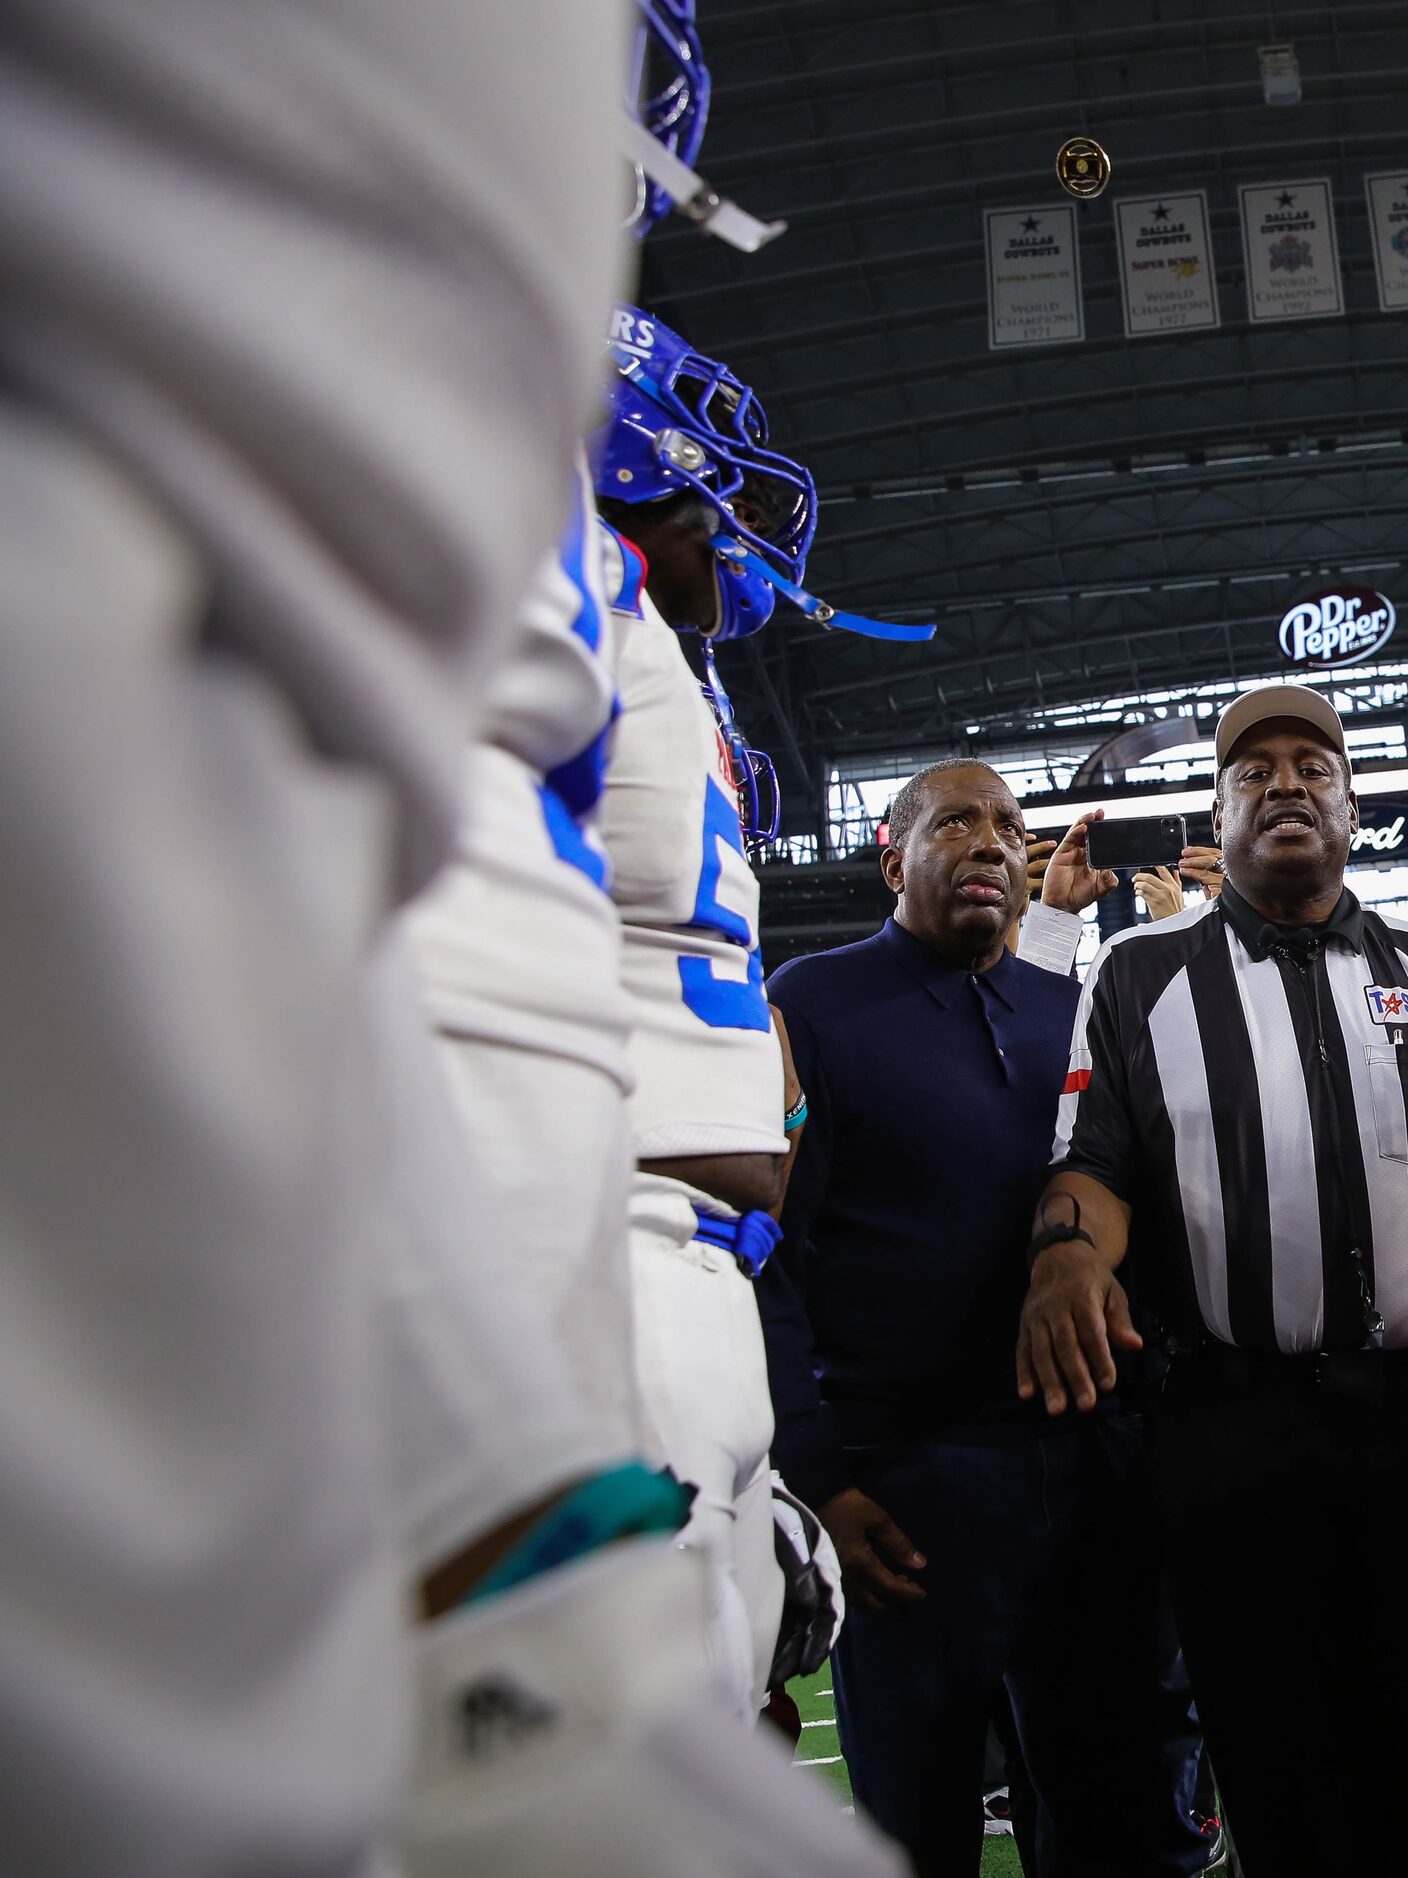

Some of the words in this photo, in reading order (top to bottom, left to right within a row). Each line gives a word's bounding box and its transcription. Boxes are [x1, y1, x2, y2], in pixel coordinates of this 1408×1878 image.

[1265, 210, 1309, 224] DALLAS
[1140, 222, 1185, 237] DALLAS
[1260, 221, 1316, 234] COWBOYS
[1009, 235, 1055, 248] DALLAS
[1136, 233, 1192, 248] COWBOYS
[1004, 245, 1060, 259] COWBOYS
[1131, 259, 1165, 272] SUPER
[1145, 289, 1195, 303] WORLD
[1011, 302, 1061, 314] WORLD
[1131, 299, 1210, 317] CHAMPIONS
[996, 314, 1075, 328] CHAMPIONS
[1319, 594, 1363, 629] Dr
[1278, 602, 1388, 661] Pepper
